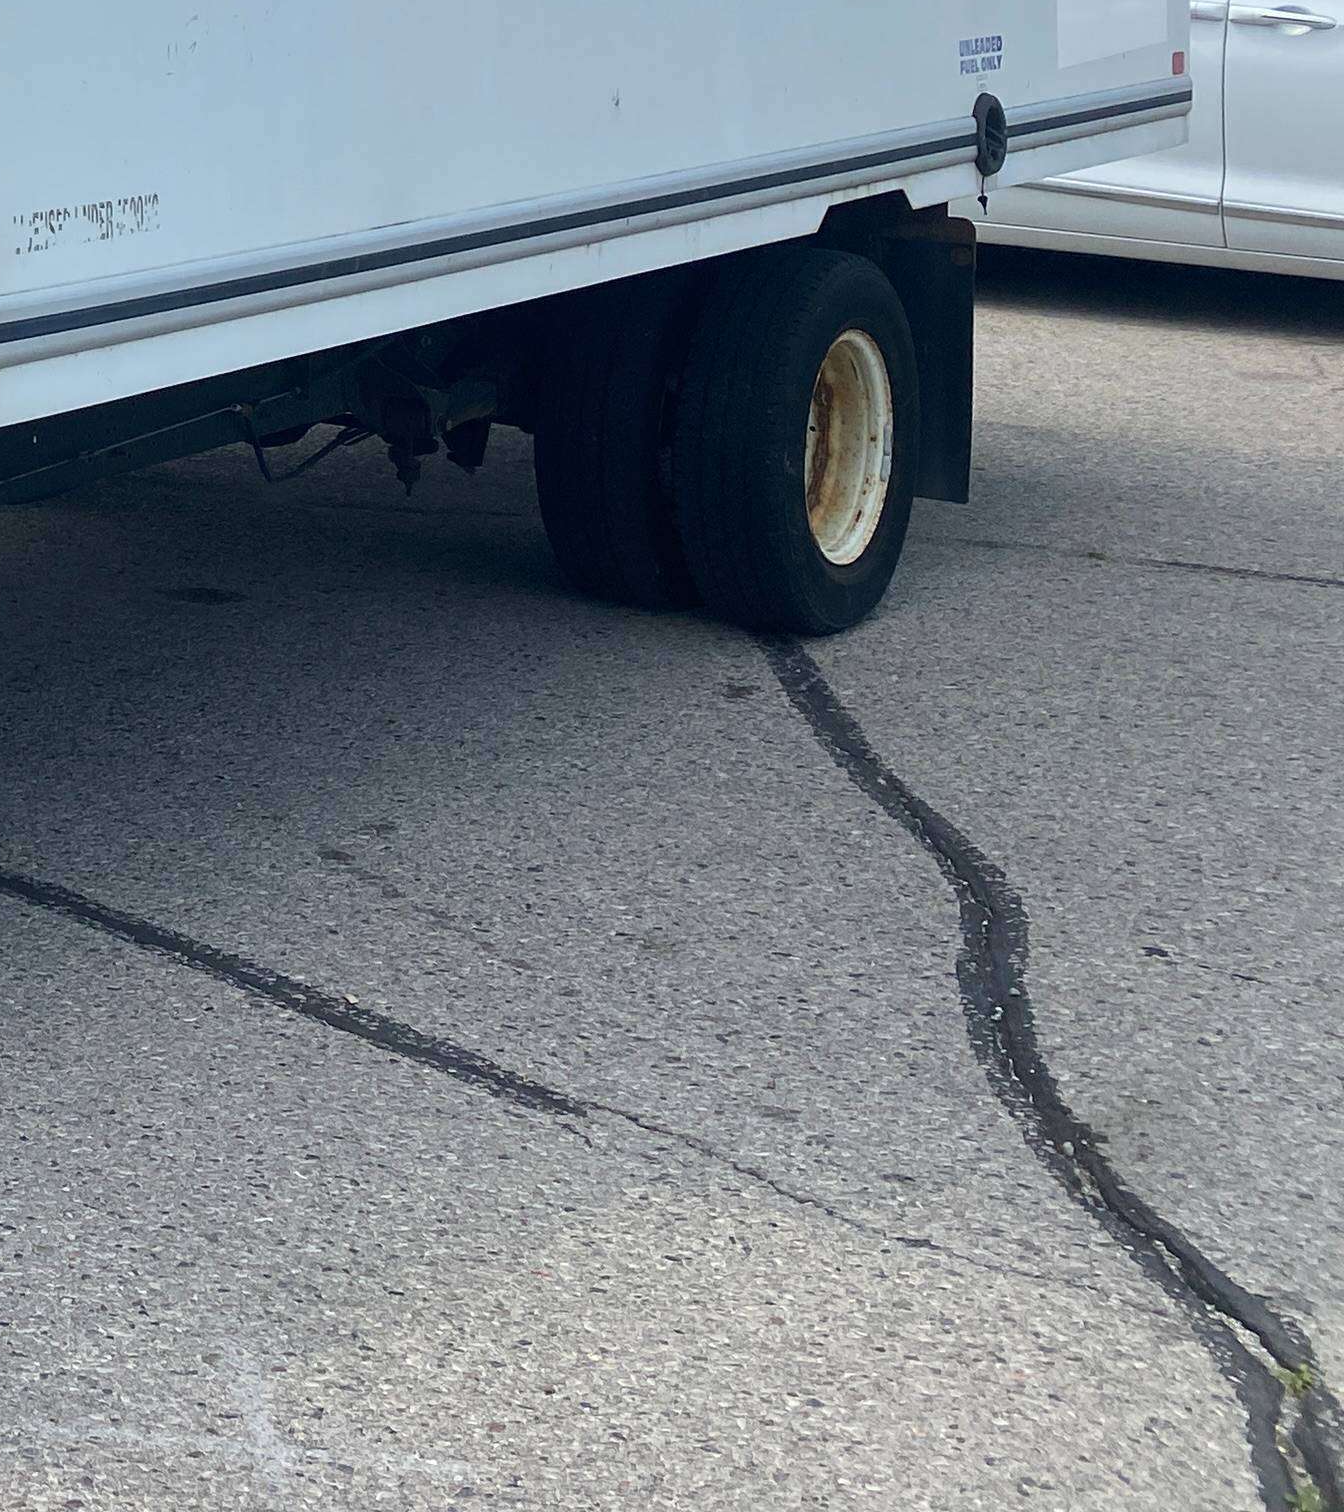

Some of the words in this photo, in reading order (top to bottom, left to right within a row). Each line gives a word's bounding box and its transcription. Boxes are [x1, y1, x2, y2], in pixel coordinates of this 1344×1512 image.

[959, 35, 1002, 57] UNLEADED
[960, 58, 980, 75] FUEL
[981, 55, 1002, 72] ONLY
